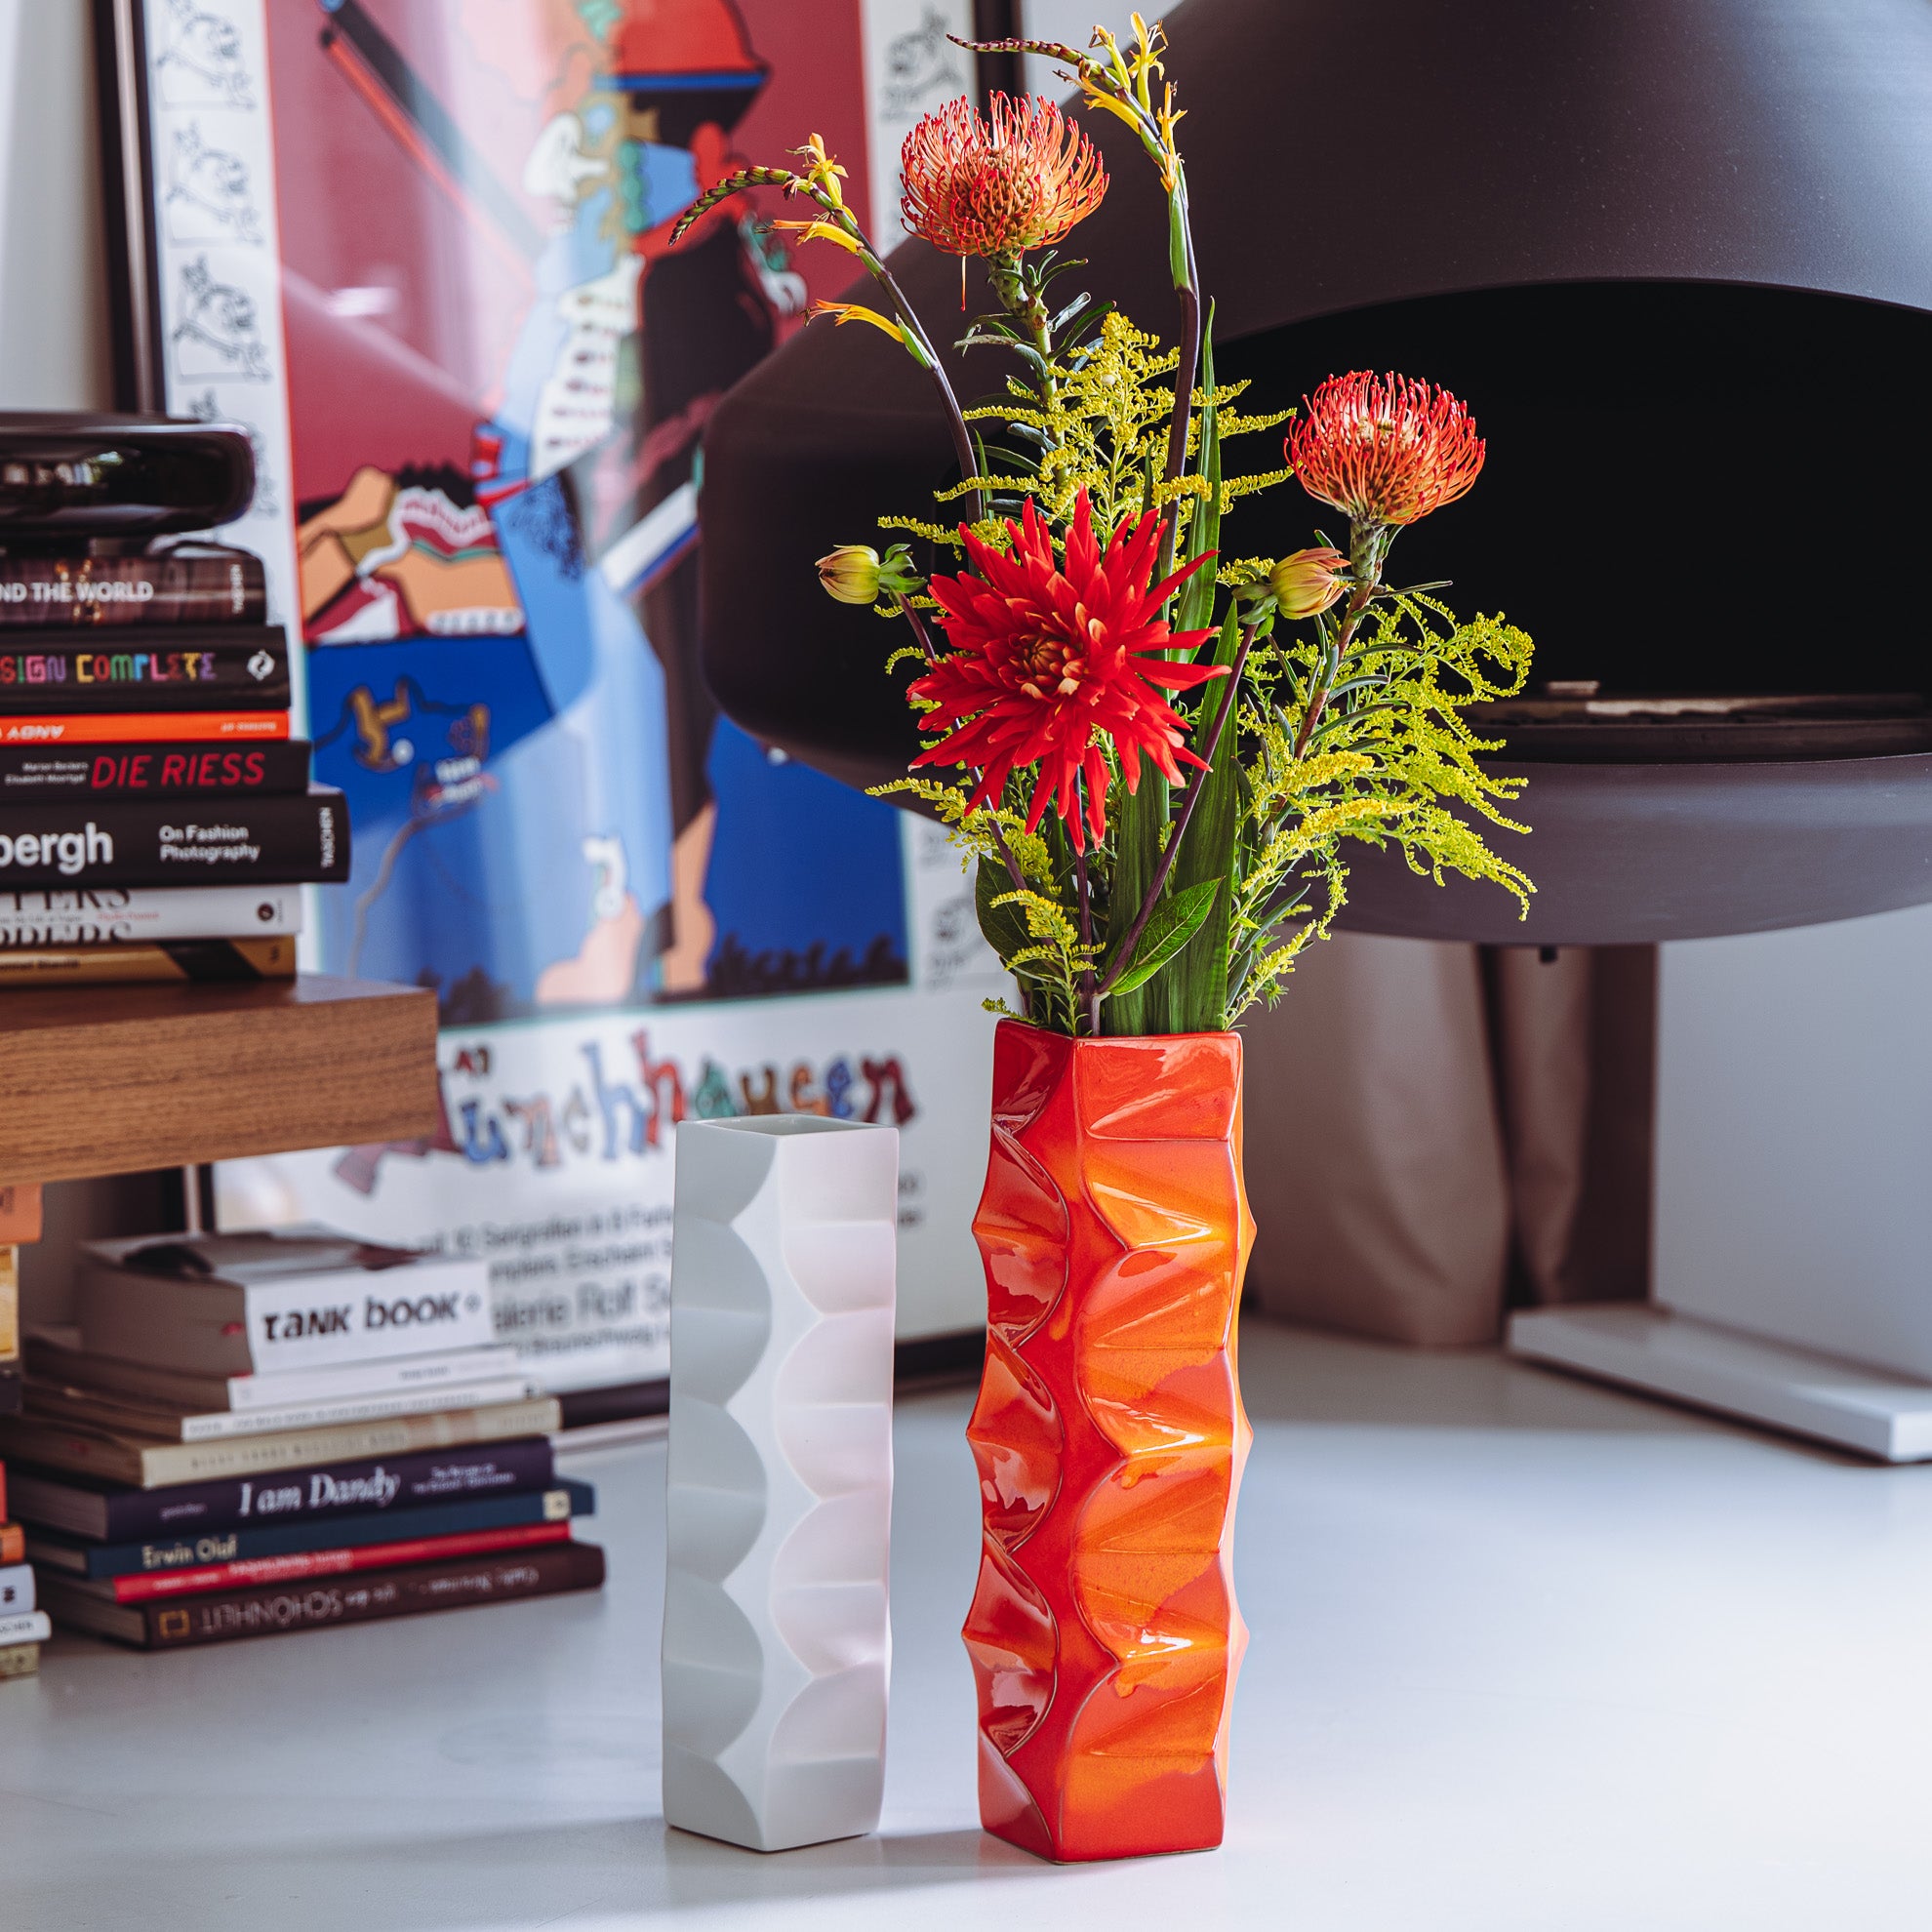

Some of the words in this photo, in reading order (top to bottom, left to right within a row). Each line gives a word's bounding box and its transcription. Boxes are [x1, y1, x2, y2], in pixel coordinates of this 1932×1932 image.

[31, 582, 73, 602] THE
[75, 581, 153, 602] WORLD
[76, 652, 217, 682] COMPLETE
[91, 755, 152, 789] DIE
[161, 752, 265, 785] RIESS
[159, 825, 183, 841] On
[185, 825, 249, 841] Fashion
[159, 843, 261, 863] Photography
[238, 1481, 255, 1517] I
[257, 1484, 302, 1514] am
[308, 1466, 401, 1509] Dandy
[142, 1543, 193, 1569] Erwin
[195, 1534, 238, 1560] Olaf
